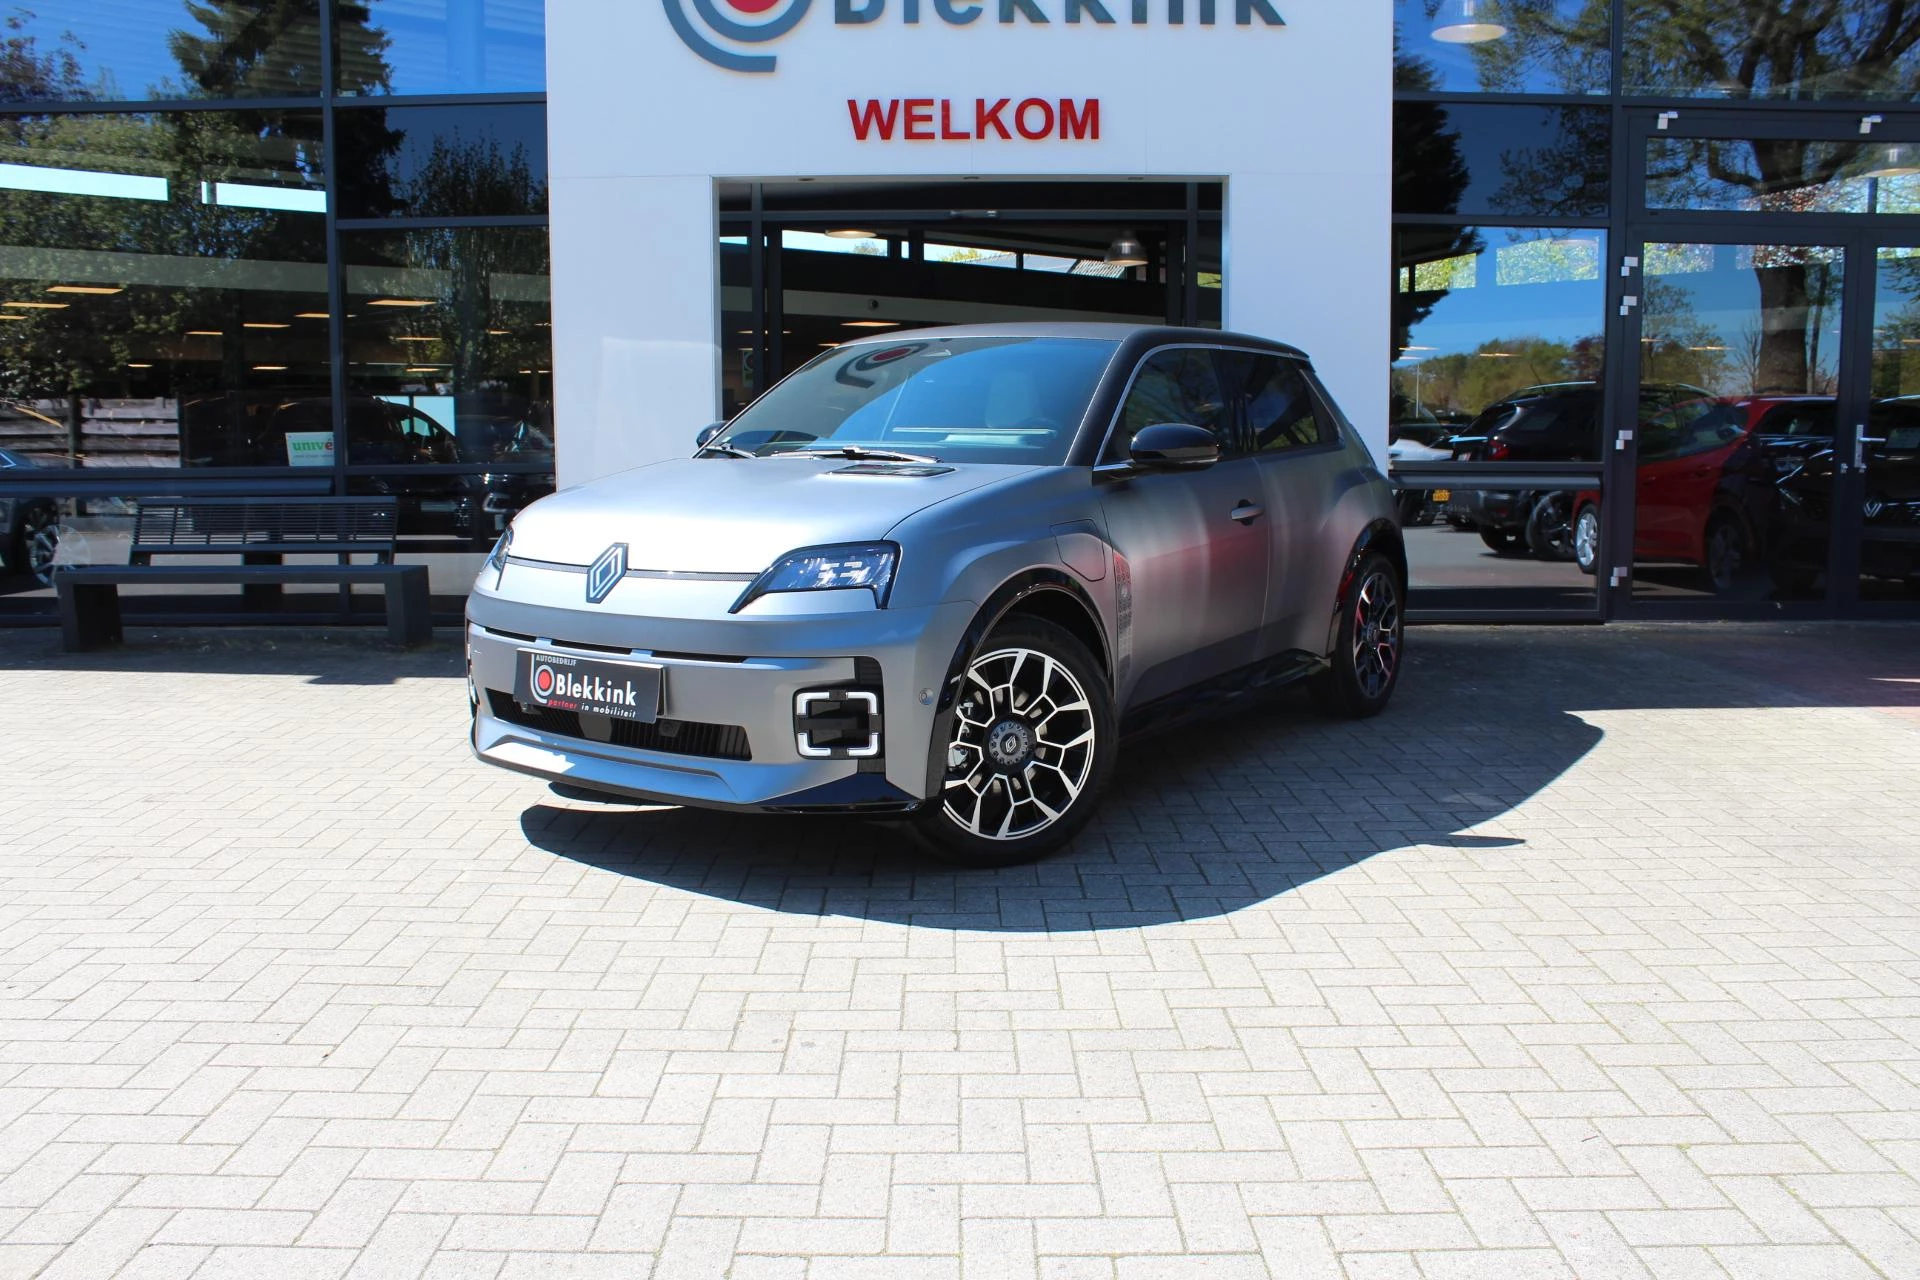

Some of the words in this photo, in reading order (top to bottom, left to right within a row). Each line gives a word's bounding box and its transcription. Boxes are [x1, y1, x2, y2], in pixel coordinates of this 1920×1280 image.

[847, 98, 1100, 140] WELKOM
[535, 654, 577, 667] AUTOBEDRIJF
[556, 673, 637, 706] Blekkink
[548, 699, 577, 709] partner
[581, 702, 590, 711] in
[593, 706, 636, 718] mobiliteit
